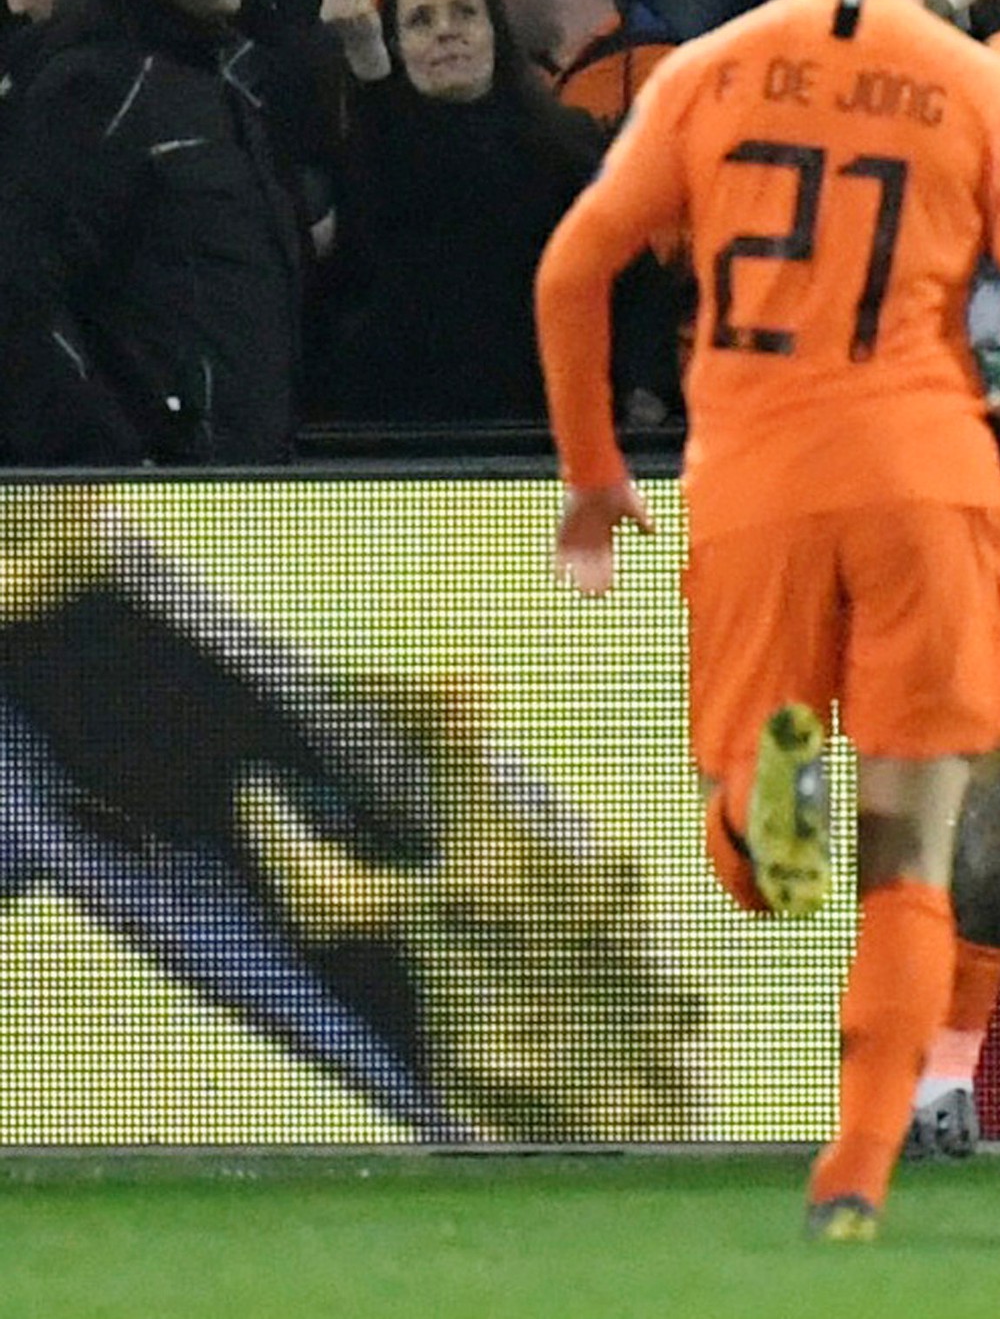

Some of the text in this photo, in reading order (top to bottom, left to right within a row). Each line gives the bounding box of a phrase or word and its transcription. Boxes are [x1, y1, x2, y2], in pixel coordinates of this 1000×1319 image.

[714, 55, 948, 127] F DE JONG
[712, 139, 909, 363] 21
